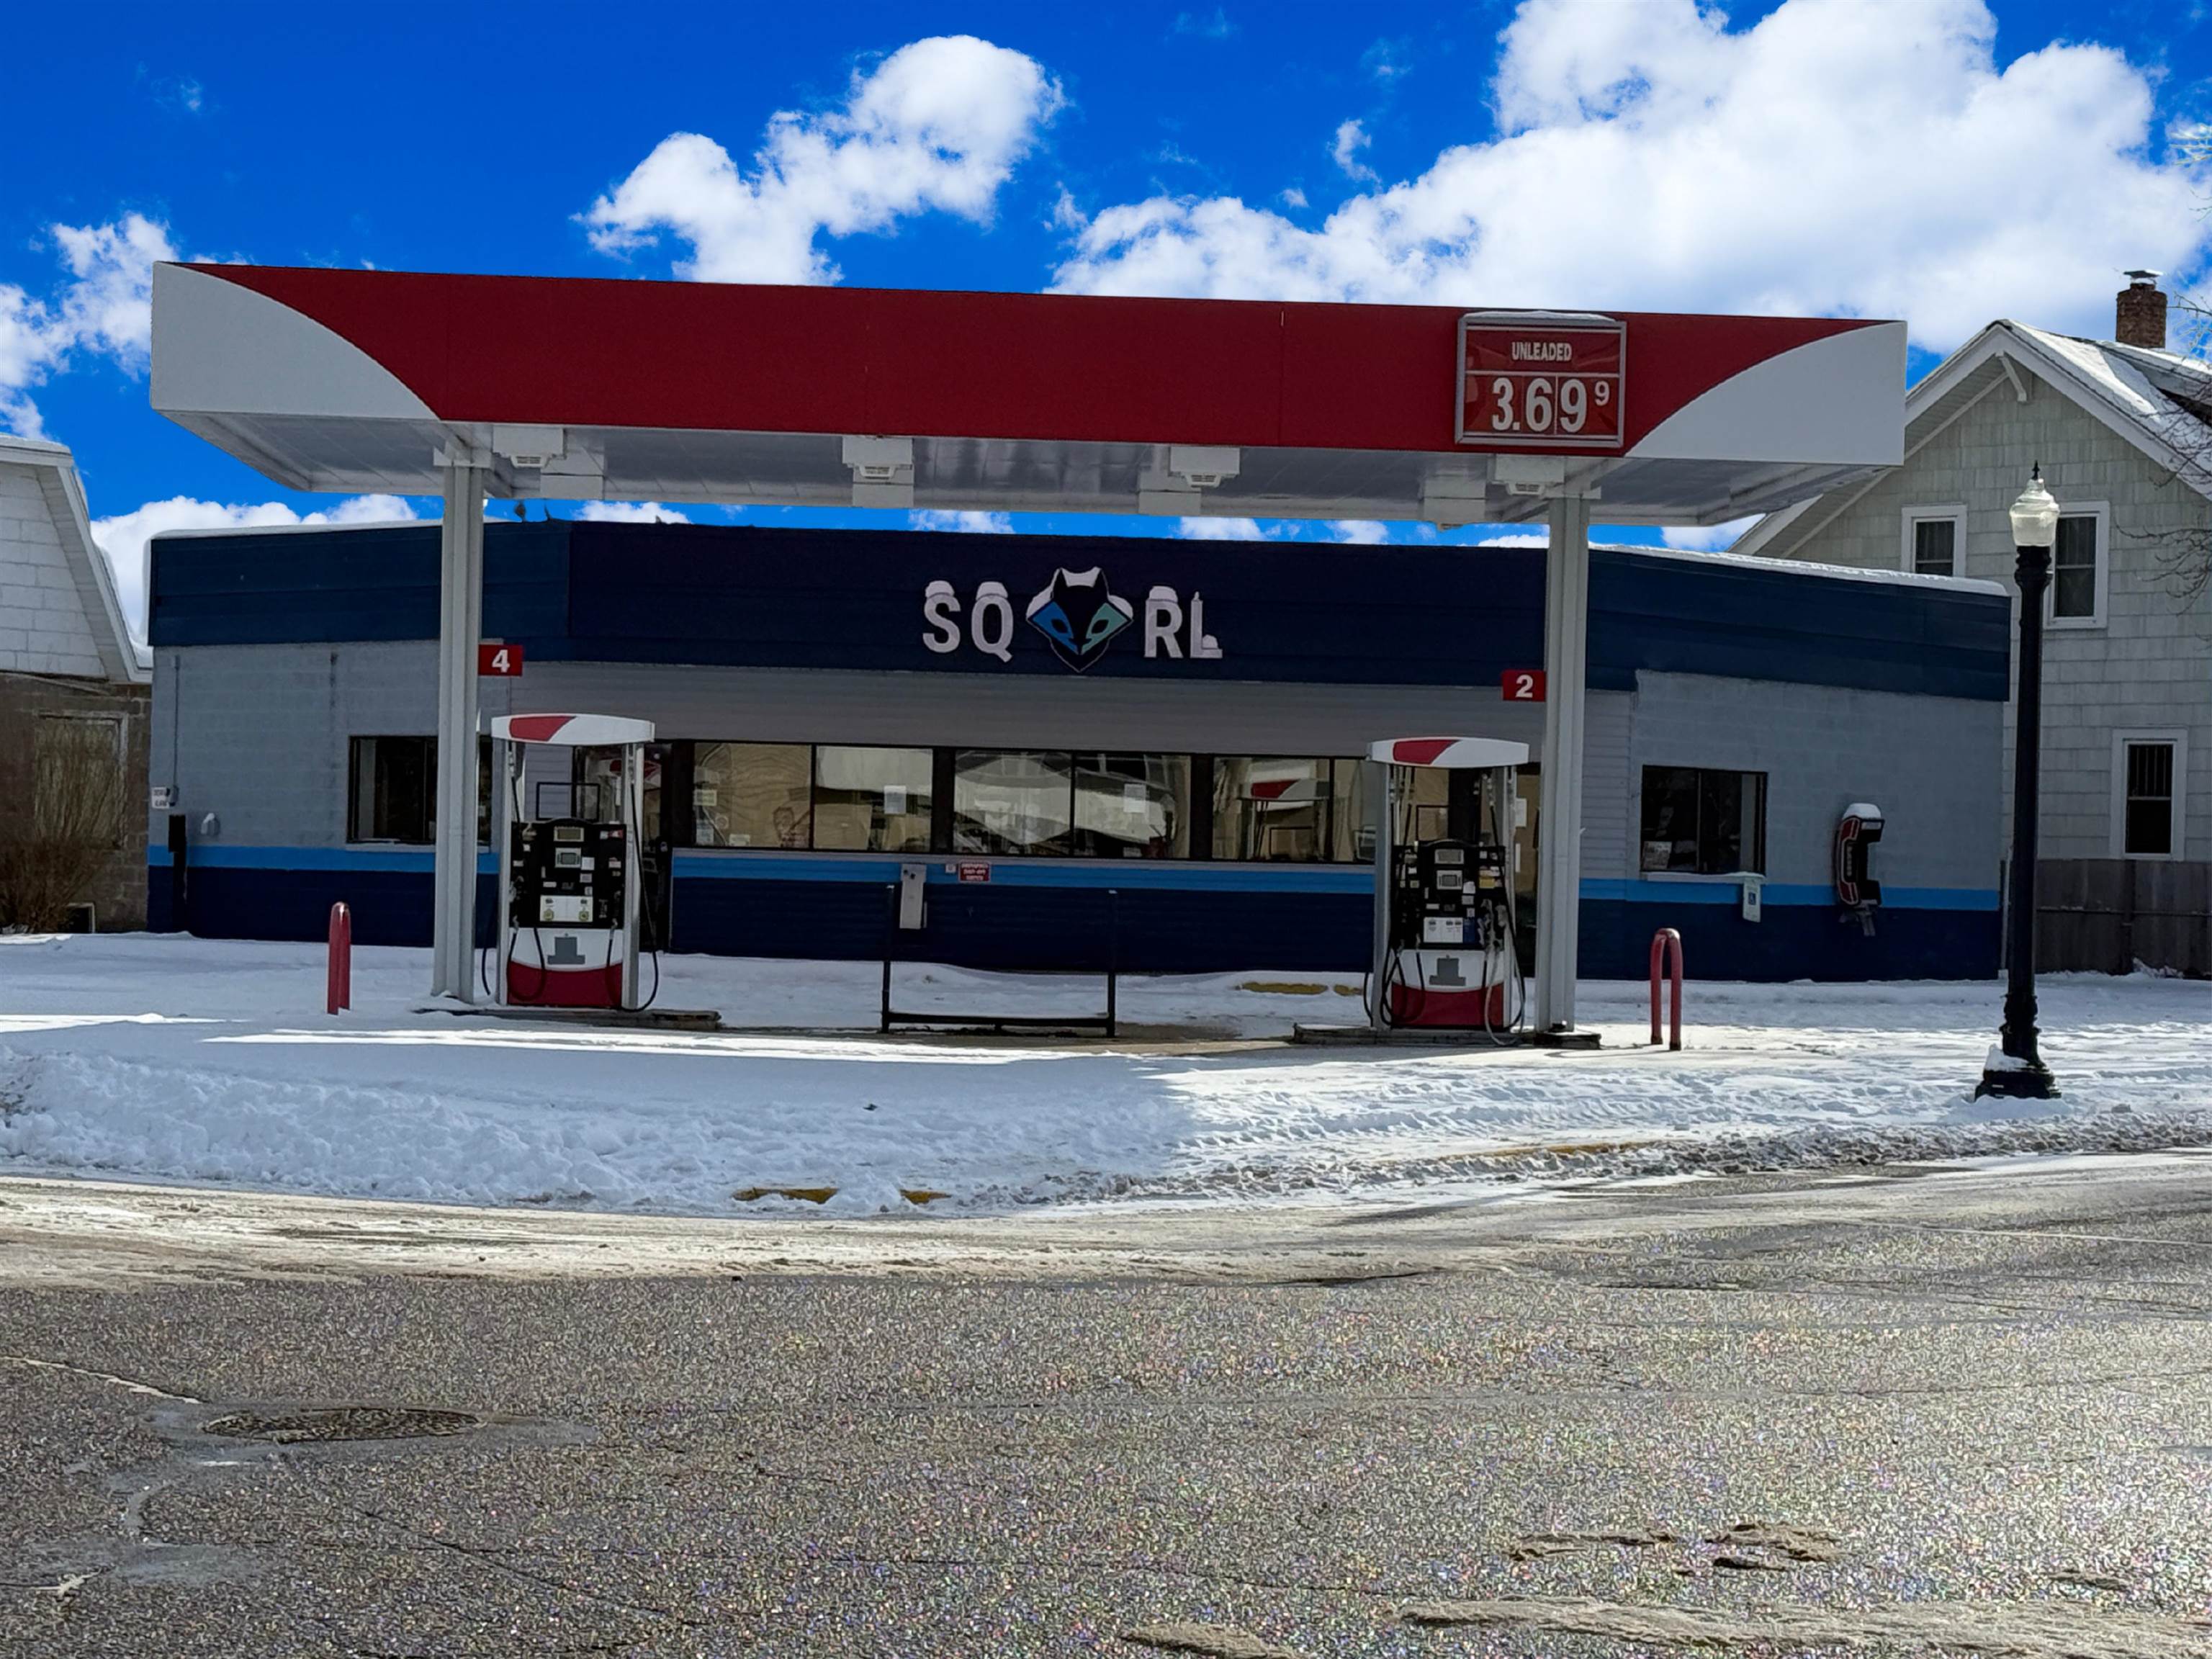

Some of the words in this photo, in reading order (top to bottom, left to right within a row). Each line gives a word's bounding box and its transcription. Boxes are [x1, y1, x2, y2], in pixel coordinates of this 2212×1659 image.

[1512, 342, 1572, 361] UNLEADED
[492, 649, 510, 673] 4
[1515, 674, 1533, 698] 2
